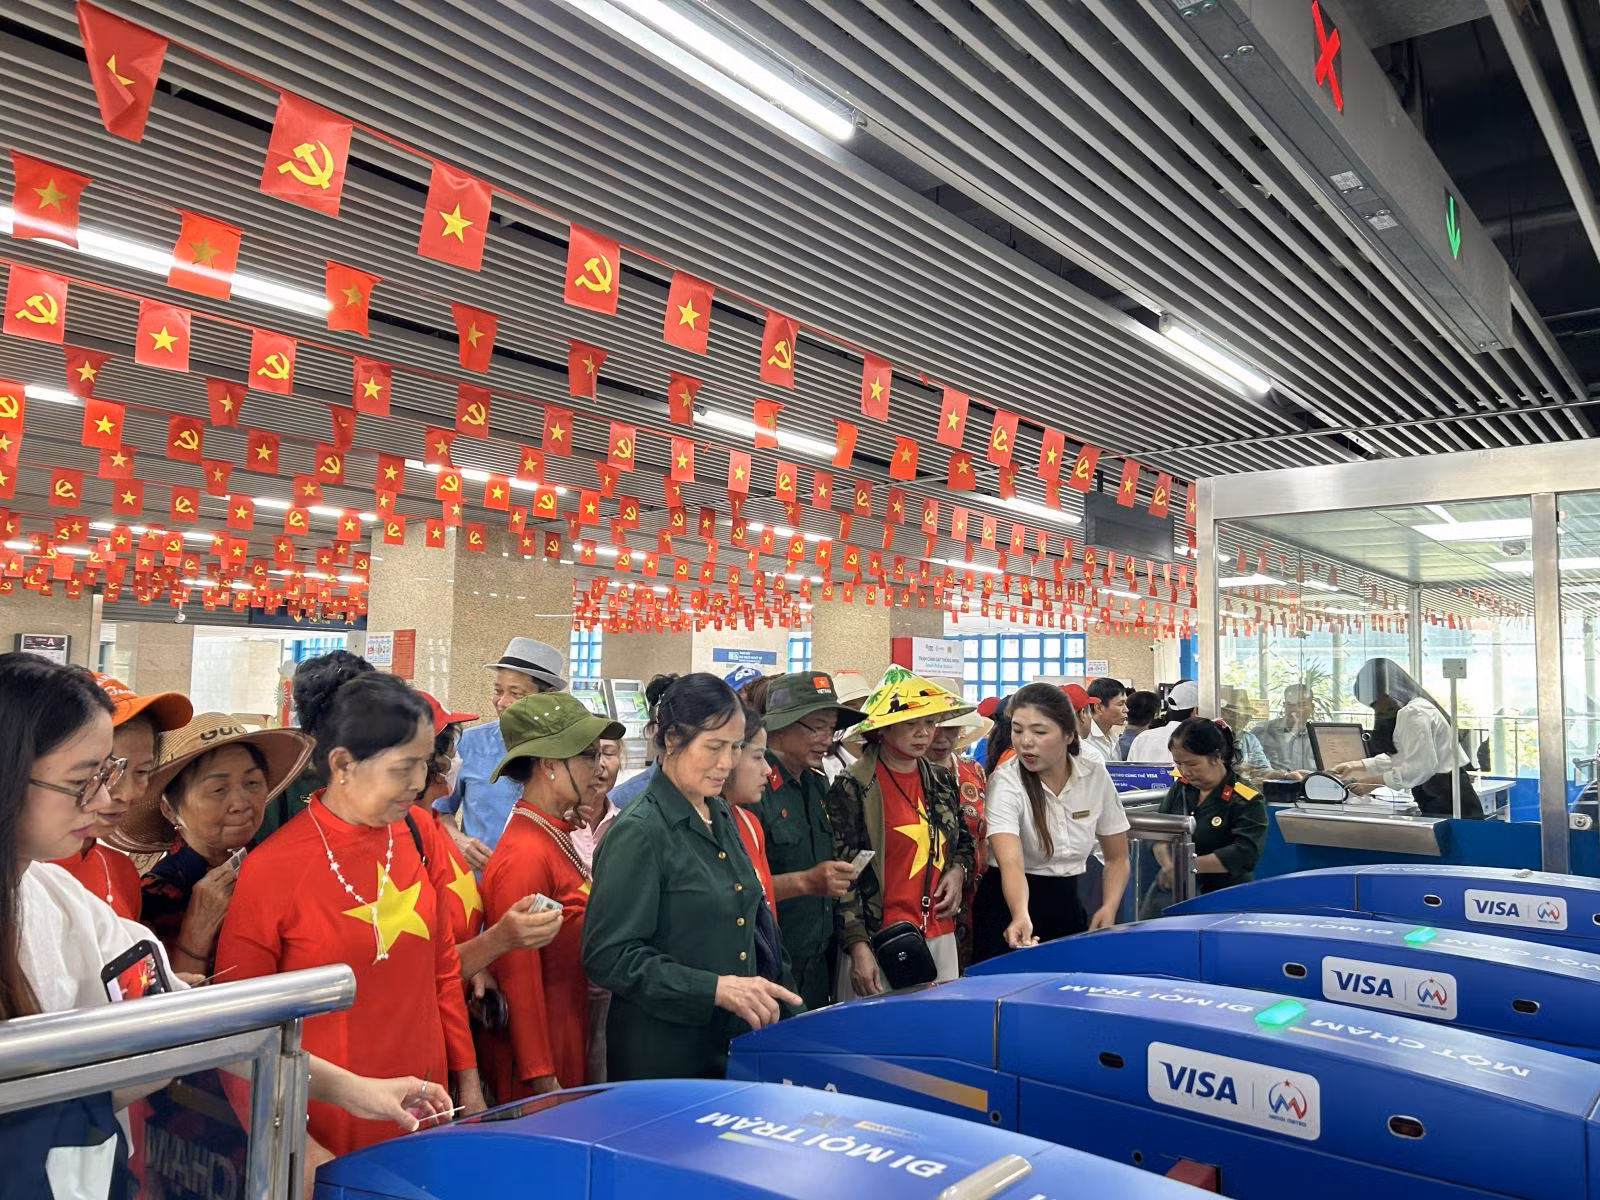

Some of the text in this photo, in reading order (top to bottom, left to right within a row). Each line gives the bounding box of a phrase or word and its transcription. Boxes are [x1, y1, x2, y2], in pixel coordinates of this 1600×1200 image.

[1472, 898, 1520, 918] VISA
[1330, 969, 1394, 999] VISA
[1158, 1060, 1238, 1105] VISA
[695, 1111, 949, 1178] ĐI MỌI TRẠM
